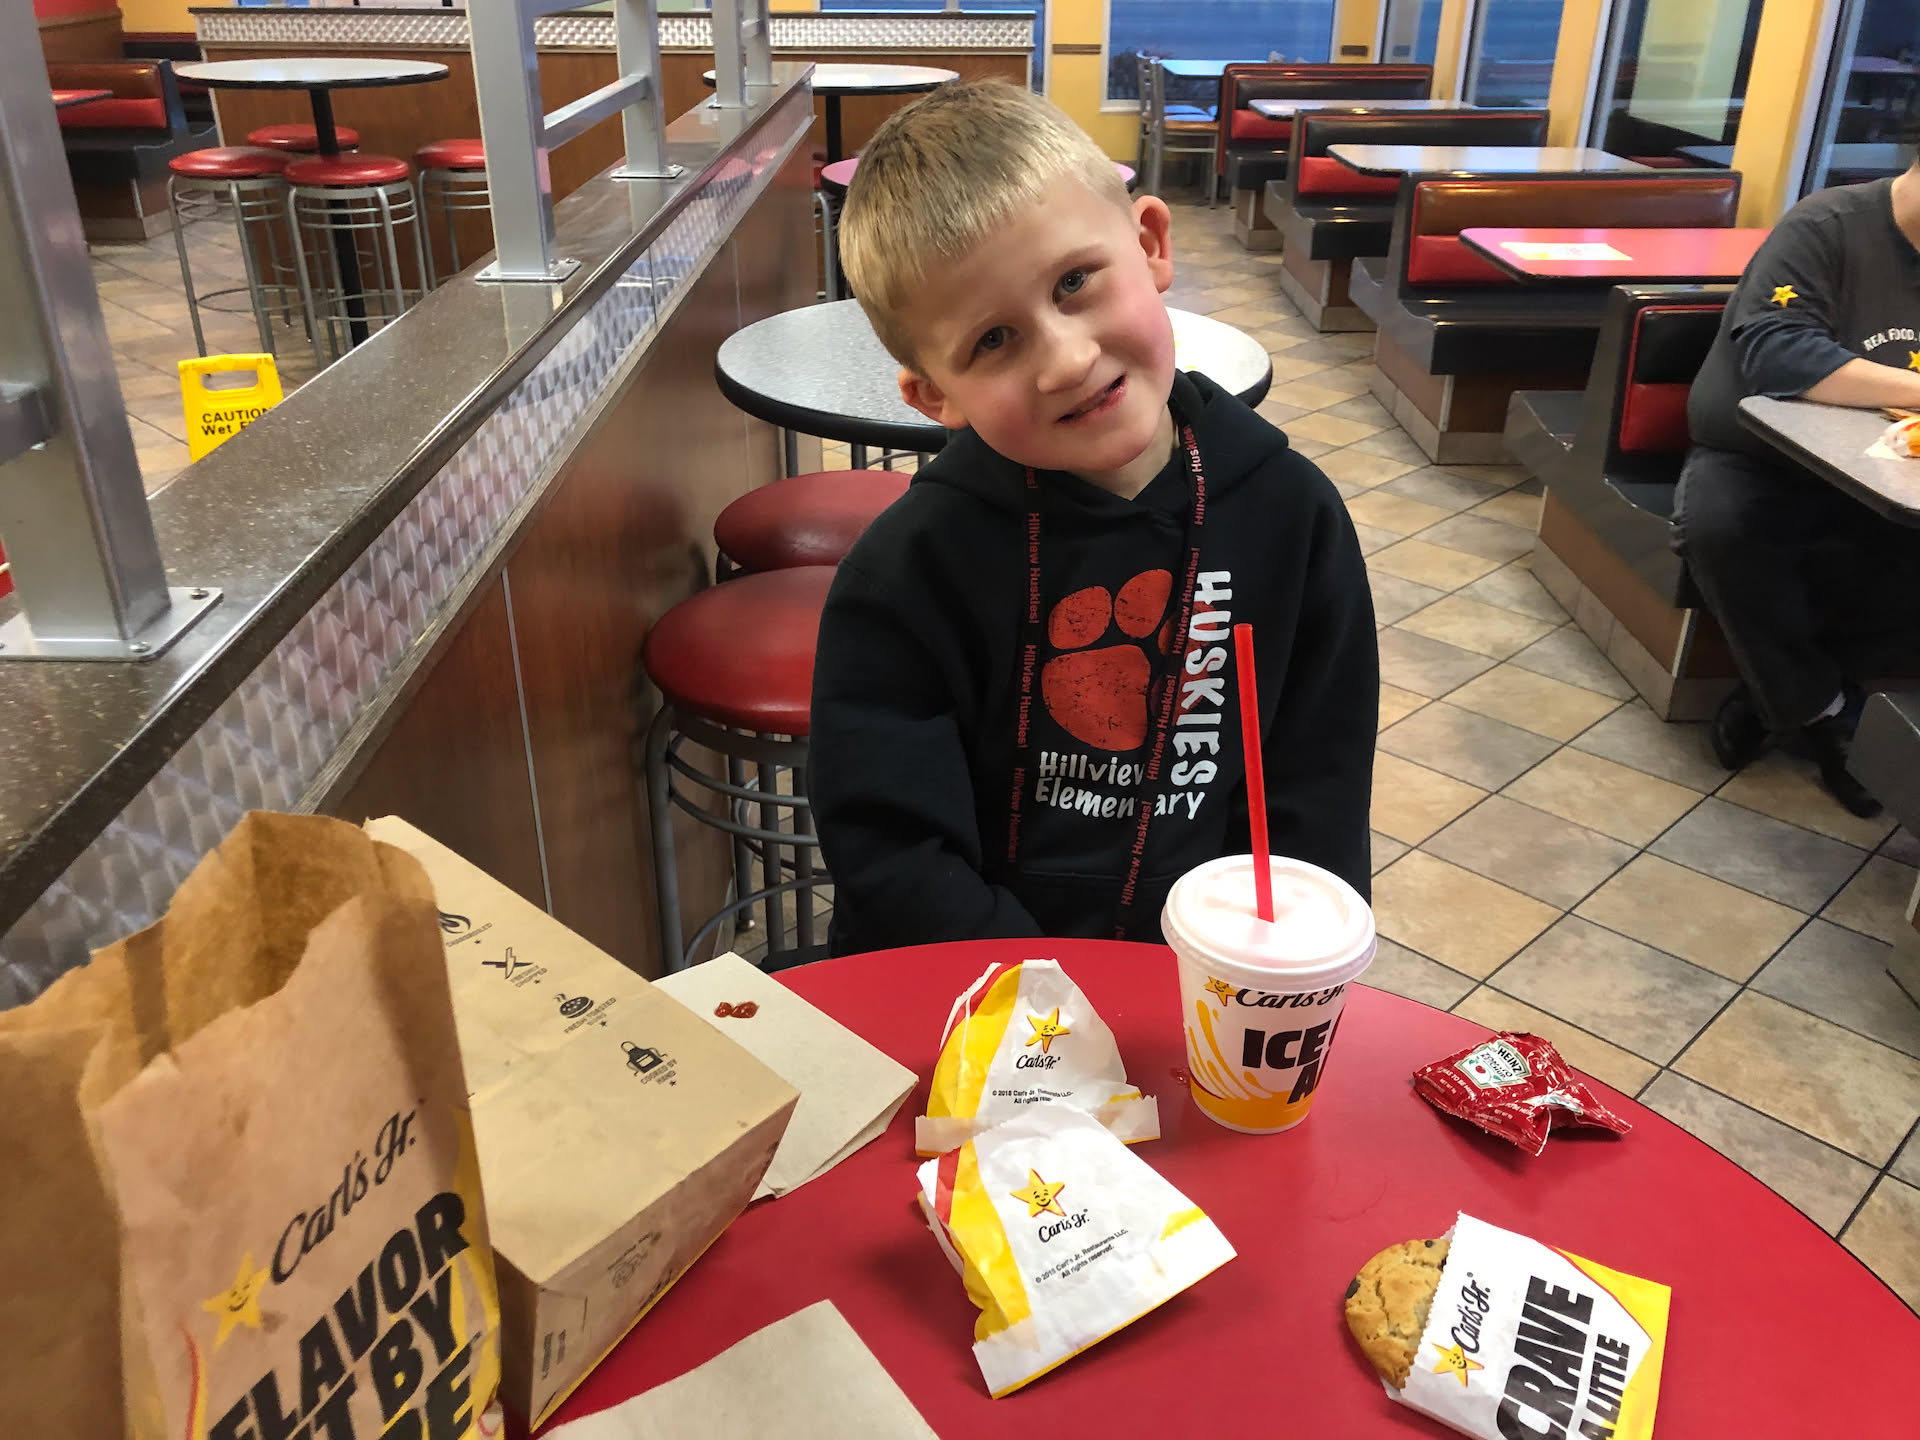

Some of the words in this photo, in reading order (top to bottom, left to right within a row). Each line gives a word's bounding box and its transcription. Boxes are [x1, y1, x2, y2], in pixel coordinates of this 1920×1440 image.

[1888, 328, 1918, 341] FOOD.
[201, 424, 233, 436] Wet
[1194, 474, 1206, 526] Hillview
[1029, 512, 1041, 564] Hillview
[1029, 567, 1041, 624] Huskies!
[1172, 605, 1190, 655] Hillview
[1181, 547, 1200, 604] Huskies!
[1020, 644, 1037, 693] Hillview
[1170, 571, 1232, 787] HUSKIES
[1017, 696, 1032, 748] Huskies!
[1146, 730, 1165, 781] Hillview
[1156, 674, 1177, 729] Huskies!
[1036, 777, 1205, 820] Elemenary
[1121, 856, 1141, 906] Hillview
[1132, 800, 1152, 856] Huskies!
[1044, 1055, 1057, 1070] Jr.
[1498, 1048, 1522, 1073] HEINZ
[1023, 1096, 1039, 1104] rights
[272, 1150, 368, 1286] Carl's
[374, 1109, 417, 1186] Jr.
[1038, 1218, 1072, 1243] Carl's
[1071, 1213, 1090, 1228] Jr.
[1056, 1258, 1074, 1272] Carl's
[1082, 1235, 1115, 1256] Restaurants
[1061, 1270, 1071, 1279] All
[1070, 1260, 1088, 1274] rights
[1088, 1244, 1114, 1263] reserved.
[1461, 1279, 1492, 1313] Jr.
[370, 1265, 458, 1426] BY
[1451, 1304, 1484, 1354] Carl's
[1496, 1275, 1595, 1440] CRAVE
[1585, 1333, 1630, 1425] LITTLE
